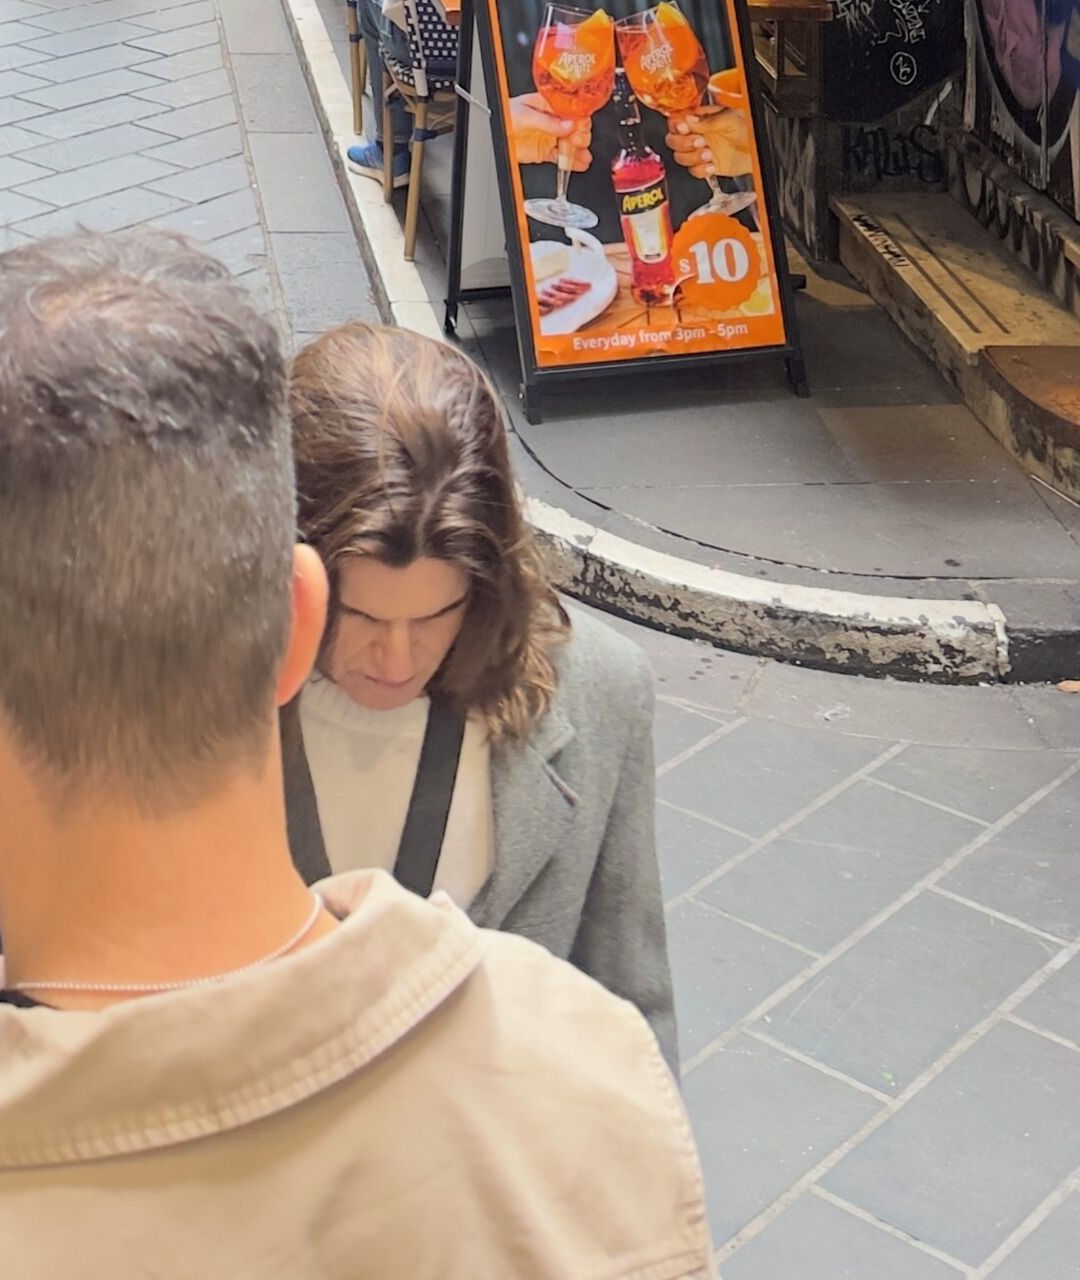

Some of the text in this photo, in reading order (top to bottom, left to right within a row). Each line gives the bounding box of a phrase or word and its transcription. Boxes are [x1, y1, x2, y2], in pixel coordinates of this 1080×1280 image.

[558, 51, 596, 65] APEROL
[640, 43, 674, 70] APEROL
[622, 188, 664, 212] APEROL
[573, 333, 636, 351] Everyday
[638, 329, 671, 343] from
[675, 326, 706, 342] 3pm
[716, 323, 748, 339] 5pm
